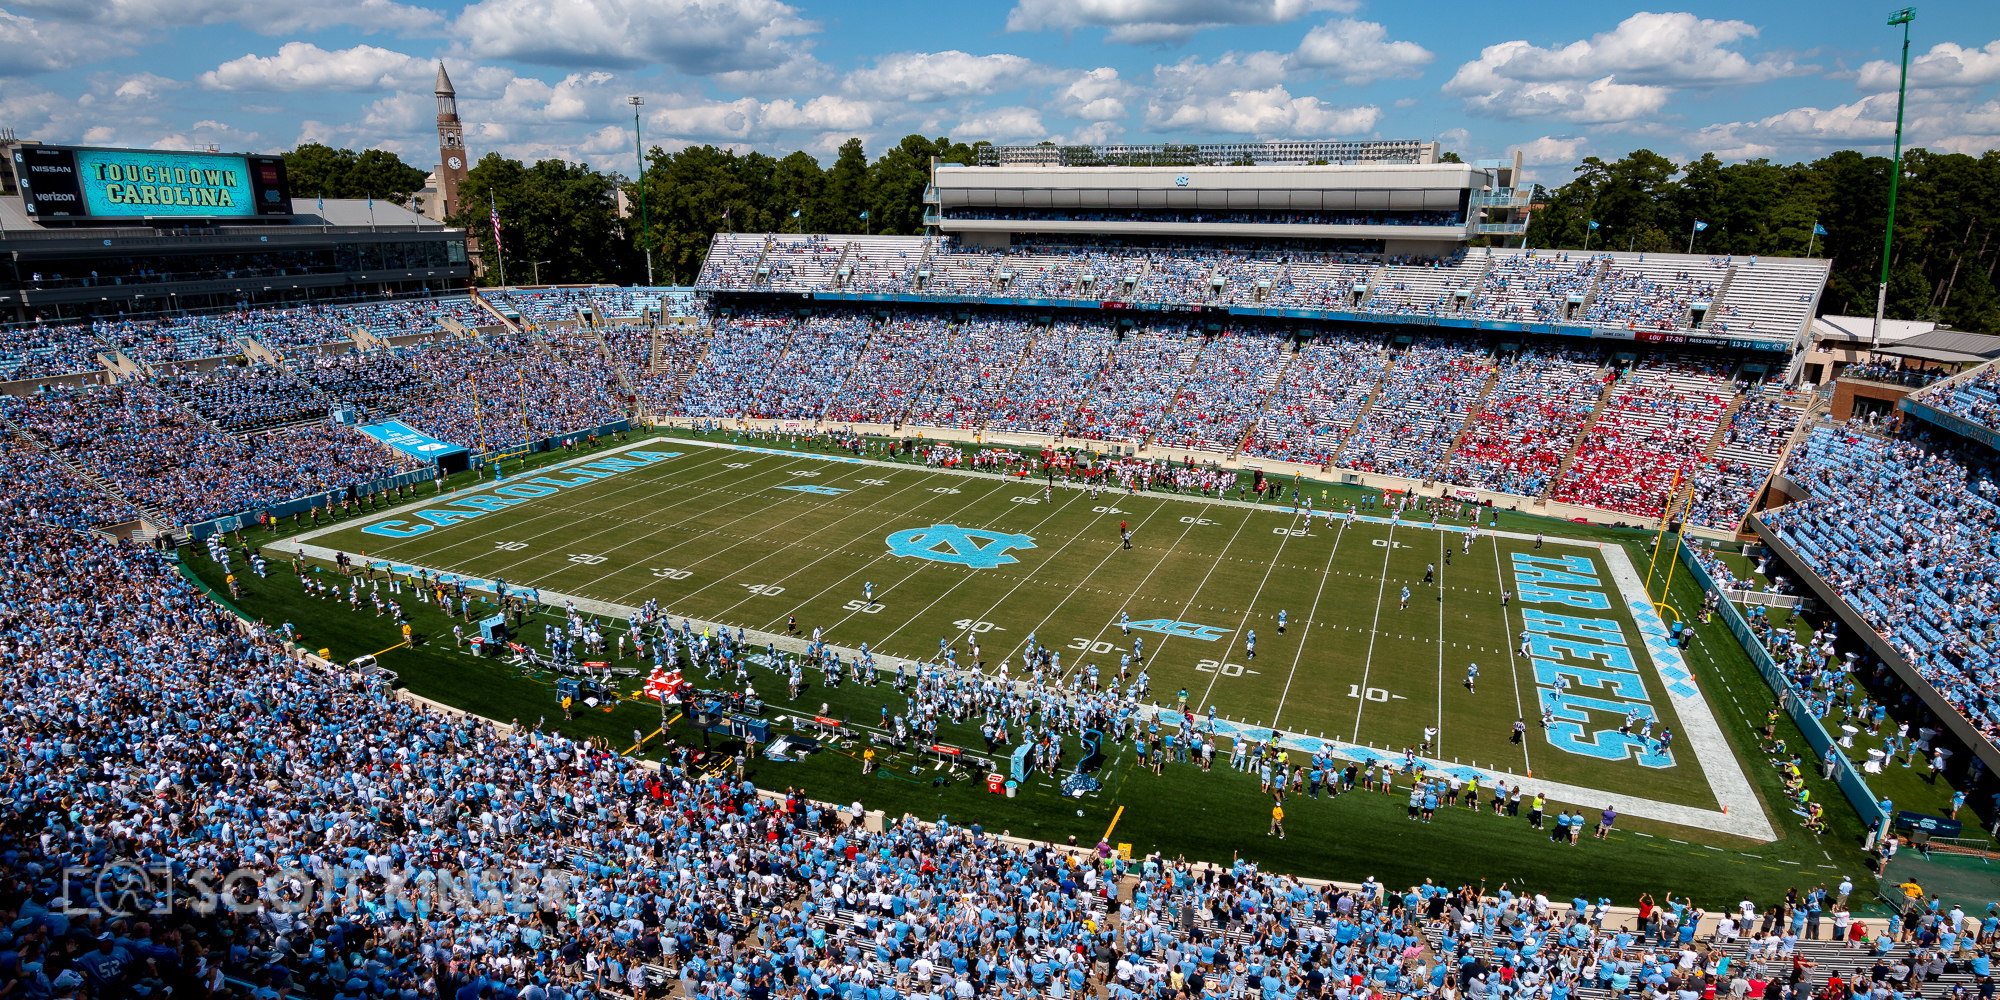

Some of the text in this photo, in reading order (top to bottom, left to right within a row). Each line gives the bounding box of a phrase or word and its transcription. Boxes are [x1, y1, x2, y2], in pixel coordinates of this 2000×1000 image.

[90, 163, 237, 187] TOUCHDOWN
[35, 191, 76, 201] verizon
[106, 184, 235, 207] CAROLINA
[958, 296, 988, 304] CAROLINA
[1354, 313, 1440, 326] TOUCHDOWN CAROLINA
[1665, 335, 1684, 343] 17-26
[1732, 340, 1770, 350] 13-17 UNC
[1966, 425, 1996, 448] CAROLINA
[479, 443, 539, 464] FOOTBALL
[356, 469, 431, 498] CAROLINA
[361, 450, 685, 538] CAROLINA
[495, 541, 529, 551] 10
[568, 553, 608, 565] 20
[653, 567, 693, 580] 30
[1511, 552, 1612, 610] TAR
[749, 583, 786, 596] 40
[842, 600, 886, 614] 50
[952, 618, 995, 633] 40
[1113, 618, 1235, 642] ACC
[1067, 637, 1115, 654] 30
[1195, 659, 1244, 677] 20
[1521, 607, 1677, 769] HEELS
[1745, 640, 1765, 671] NORTH
[1766, 666, 1799, 720] CAROINA
[1347, 684, 1389, 702] 10
[98, 960, 121, 979] 52
